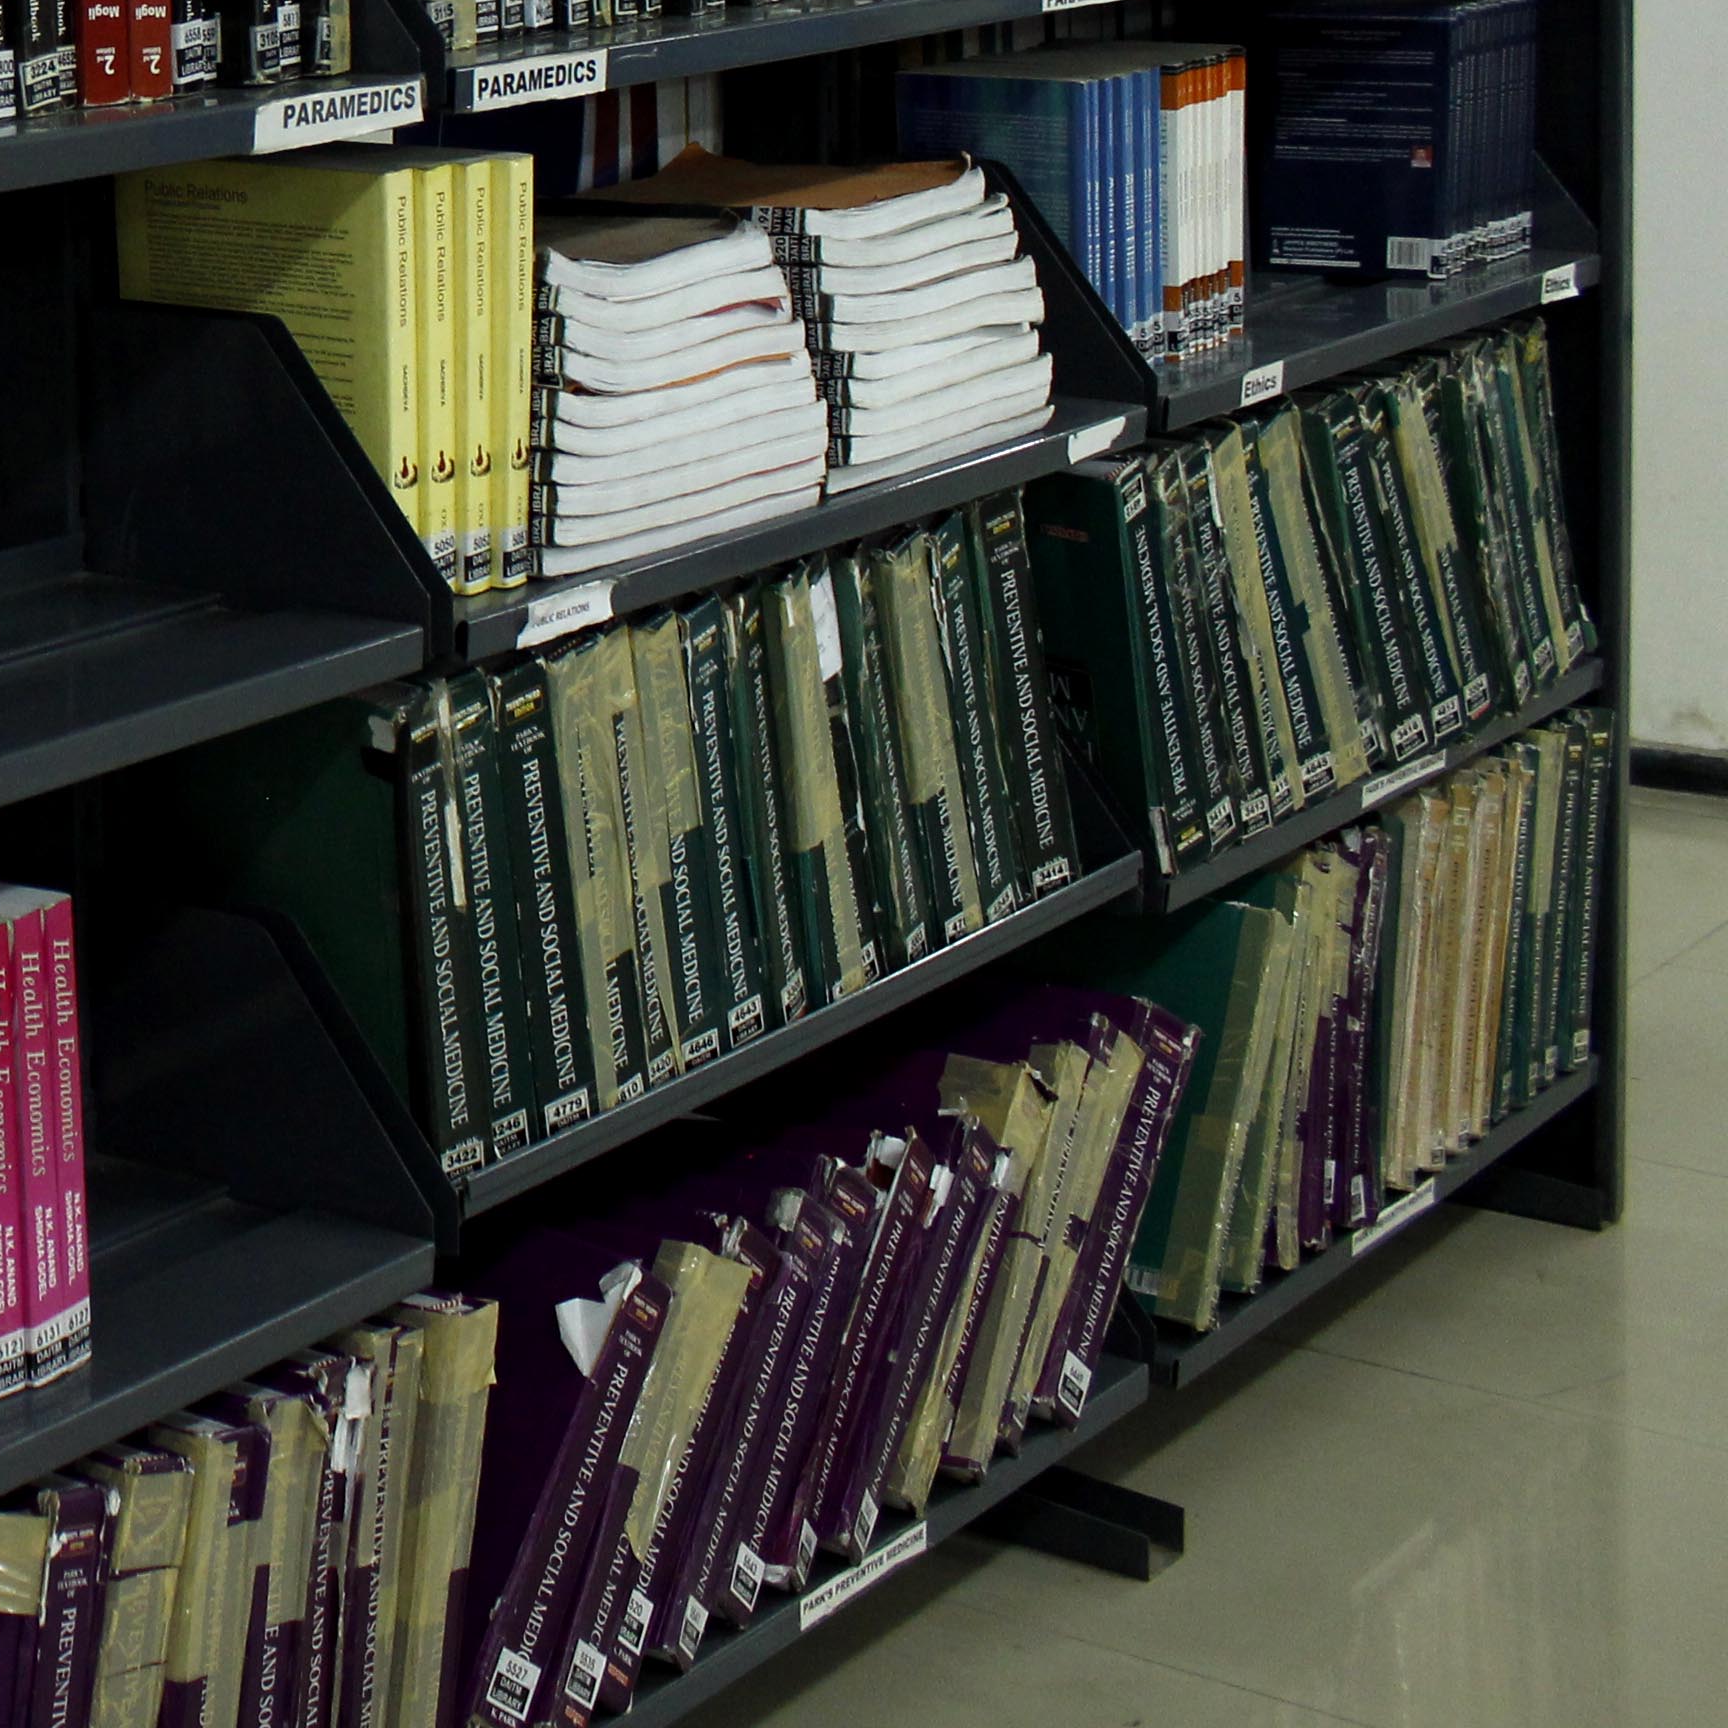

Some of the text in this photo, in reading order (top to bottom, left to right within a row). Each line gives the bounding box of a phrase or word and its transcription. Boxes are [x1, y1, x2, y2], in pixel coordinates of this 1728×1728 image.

[88, 6, 120, 20] Mogli
[477, 61, 597, 100] PARAMEDICS
[283, 82, 416, 128] PARAMEDICS
[144, 181, 247, 203] Public Relations
[398, 196, 409, 328] Public Relations
[1546, 277, 1570, 292] Ethics
[1245, 375, 1277, 397] Ethics
[1345, 468, 1410, 710] PREVENTIVE AND SOCIAL MEDICINE
[521, 759, 575, 1089] PREVENTIVE AND SOCIAL MEDICINE
[54, 939, 76, 1163] Health Economics
[552, 1097, 582, 1117] 4779
[37, 1322, 62, 1348] 6131
[541, 1362, 628, 1597] PREVENTIVE AND SOCIAL
[804, 1588, 833, 1613] PARK'S
[835, 1555, 883, 1594] PREVENTIVE
[500, 1673, 523, 1692] DAITM
[506, 1659, 528, 1680] 5527
